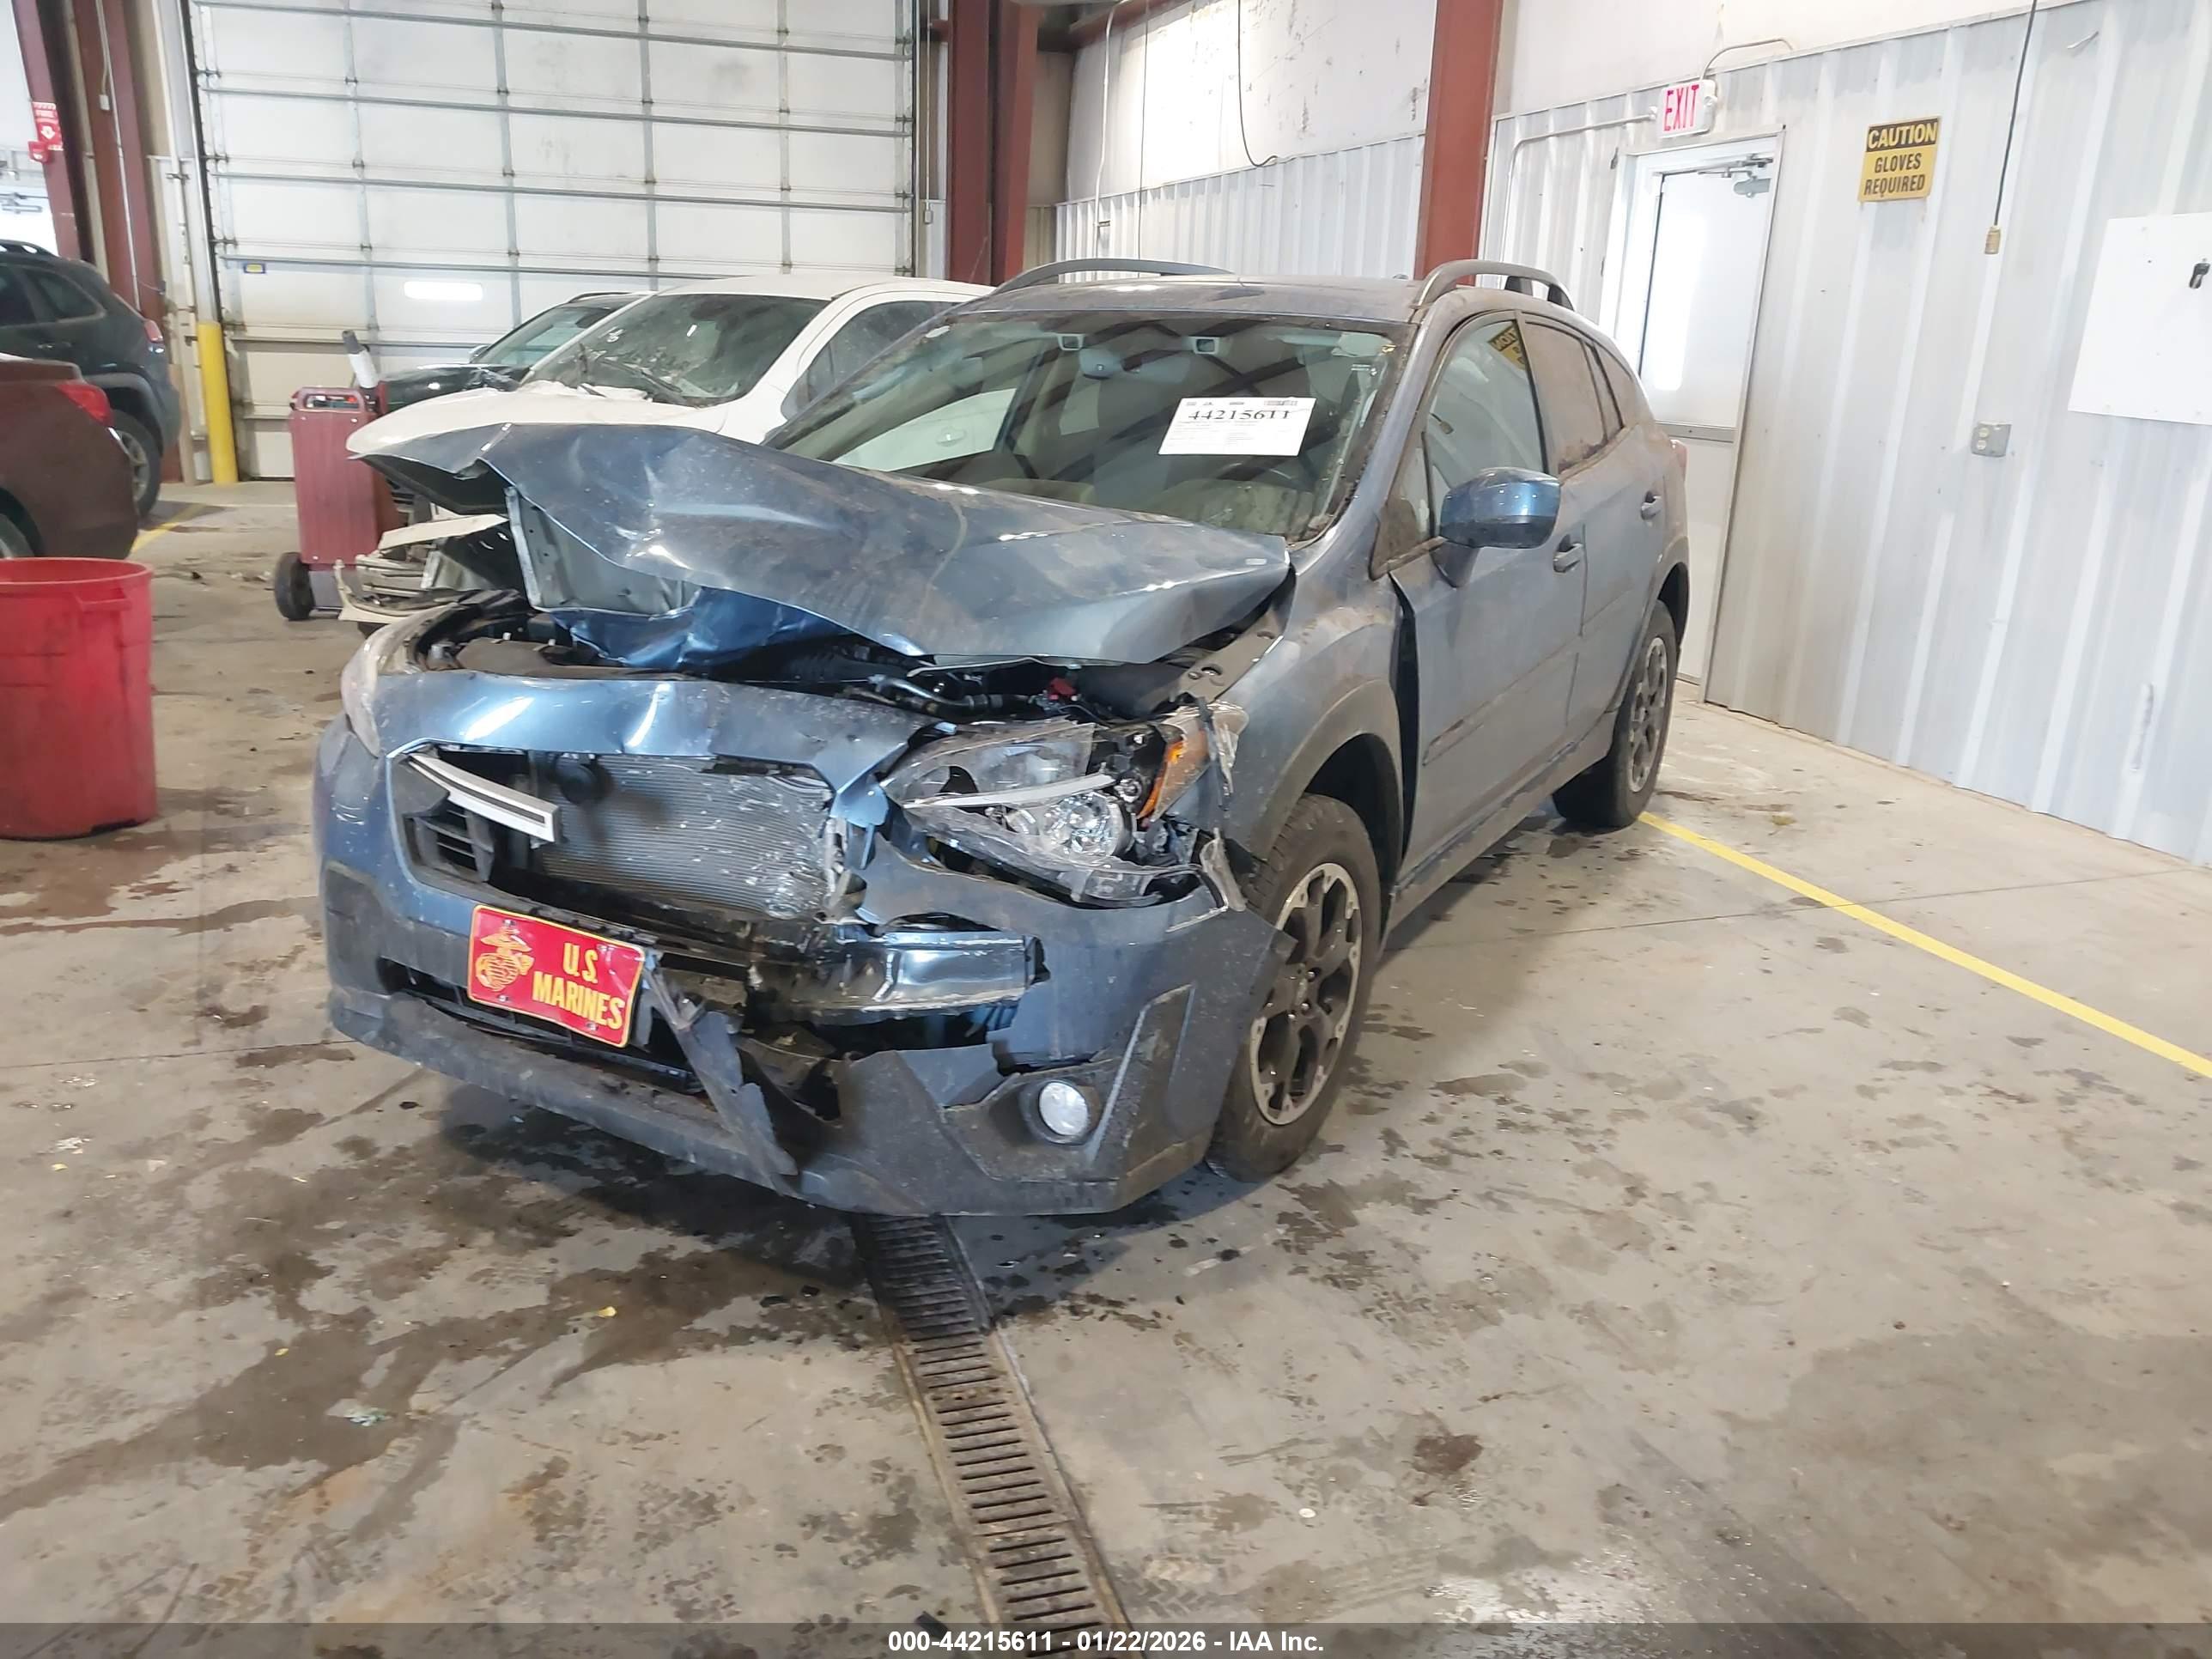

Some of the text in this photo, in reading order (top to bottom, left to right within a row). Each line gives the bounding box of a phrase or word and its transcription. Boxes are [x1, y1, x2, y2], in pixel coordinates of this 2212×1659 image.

[1663, 83, 1700, 131] EXIT
[1868, 122, 1938, 149] CAUTION
[1874, 152, 1923, 174] GLOVES
[1863, 173, 1925, 198] REQUIRED
[1188, 409, 1292, 420] 44215611
[532, 971, 626, 1030] MARINES
